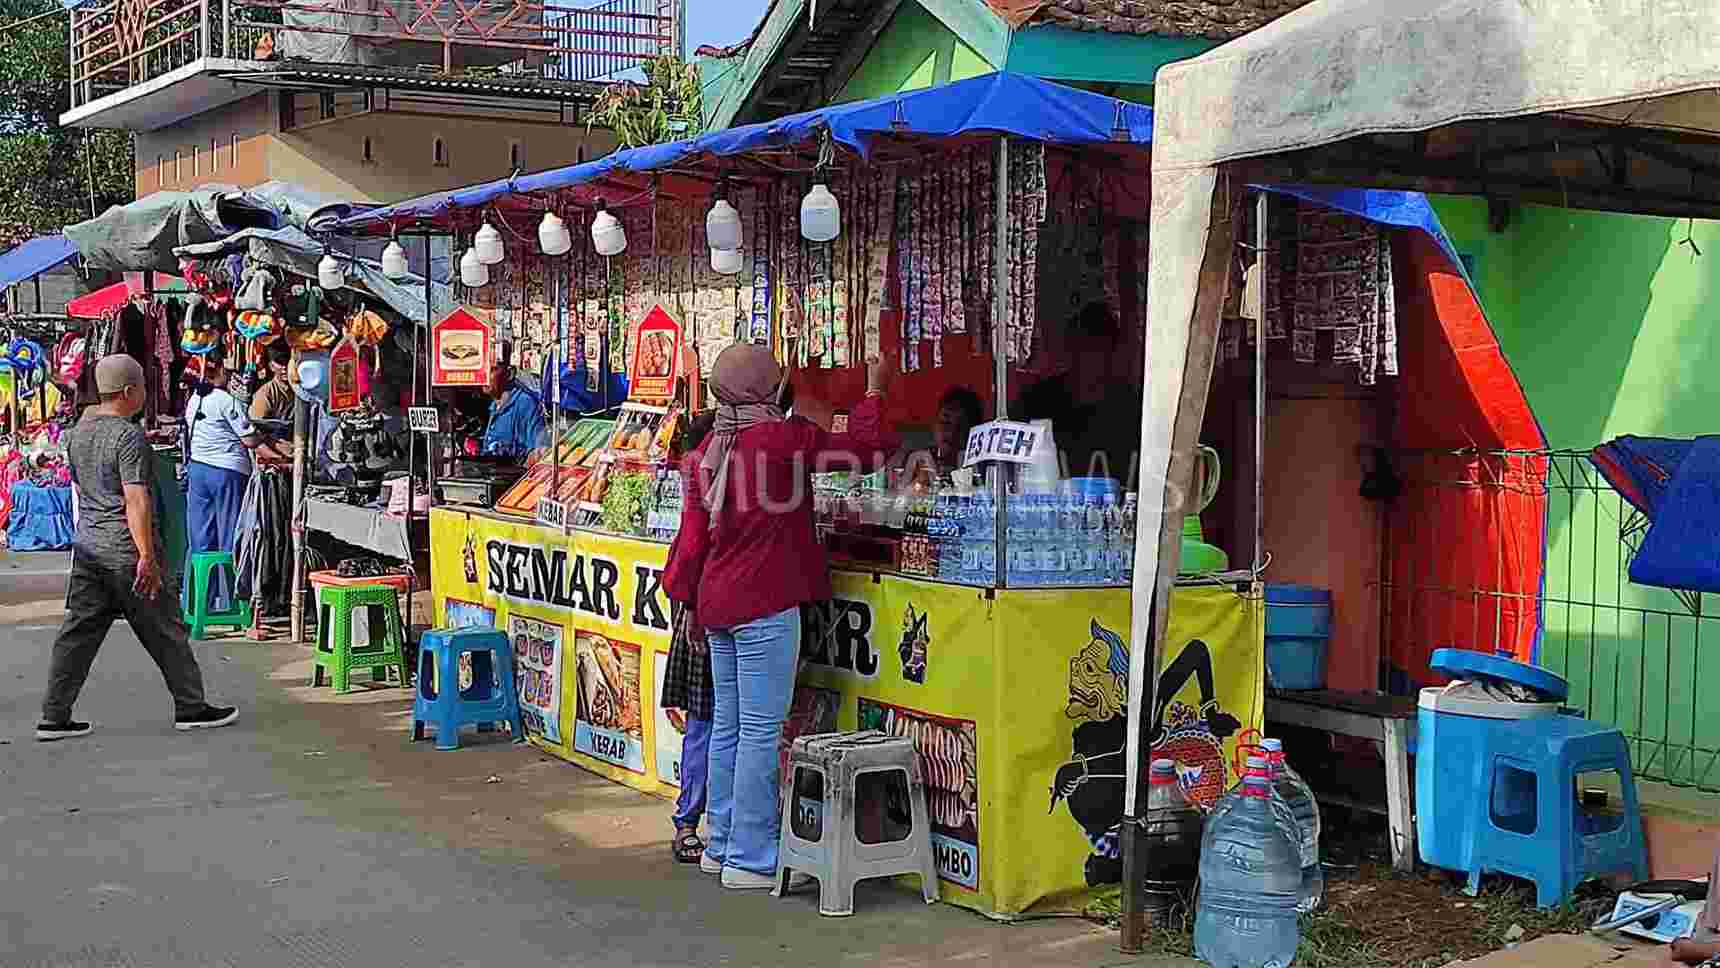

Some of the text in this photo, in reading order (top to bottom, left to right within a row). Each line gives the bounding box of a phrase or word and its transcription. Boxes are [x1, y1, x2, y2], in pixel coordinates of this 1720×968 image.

[969, 427, 1035, 458] ES TEH
[487, 540, 878, 676] SEMAR K ER
[591, 732, 626, 760] KEBAB
